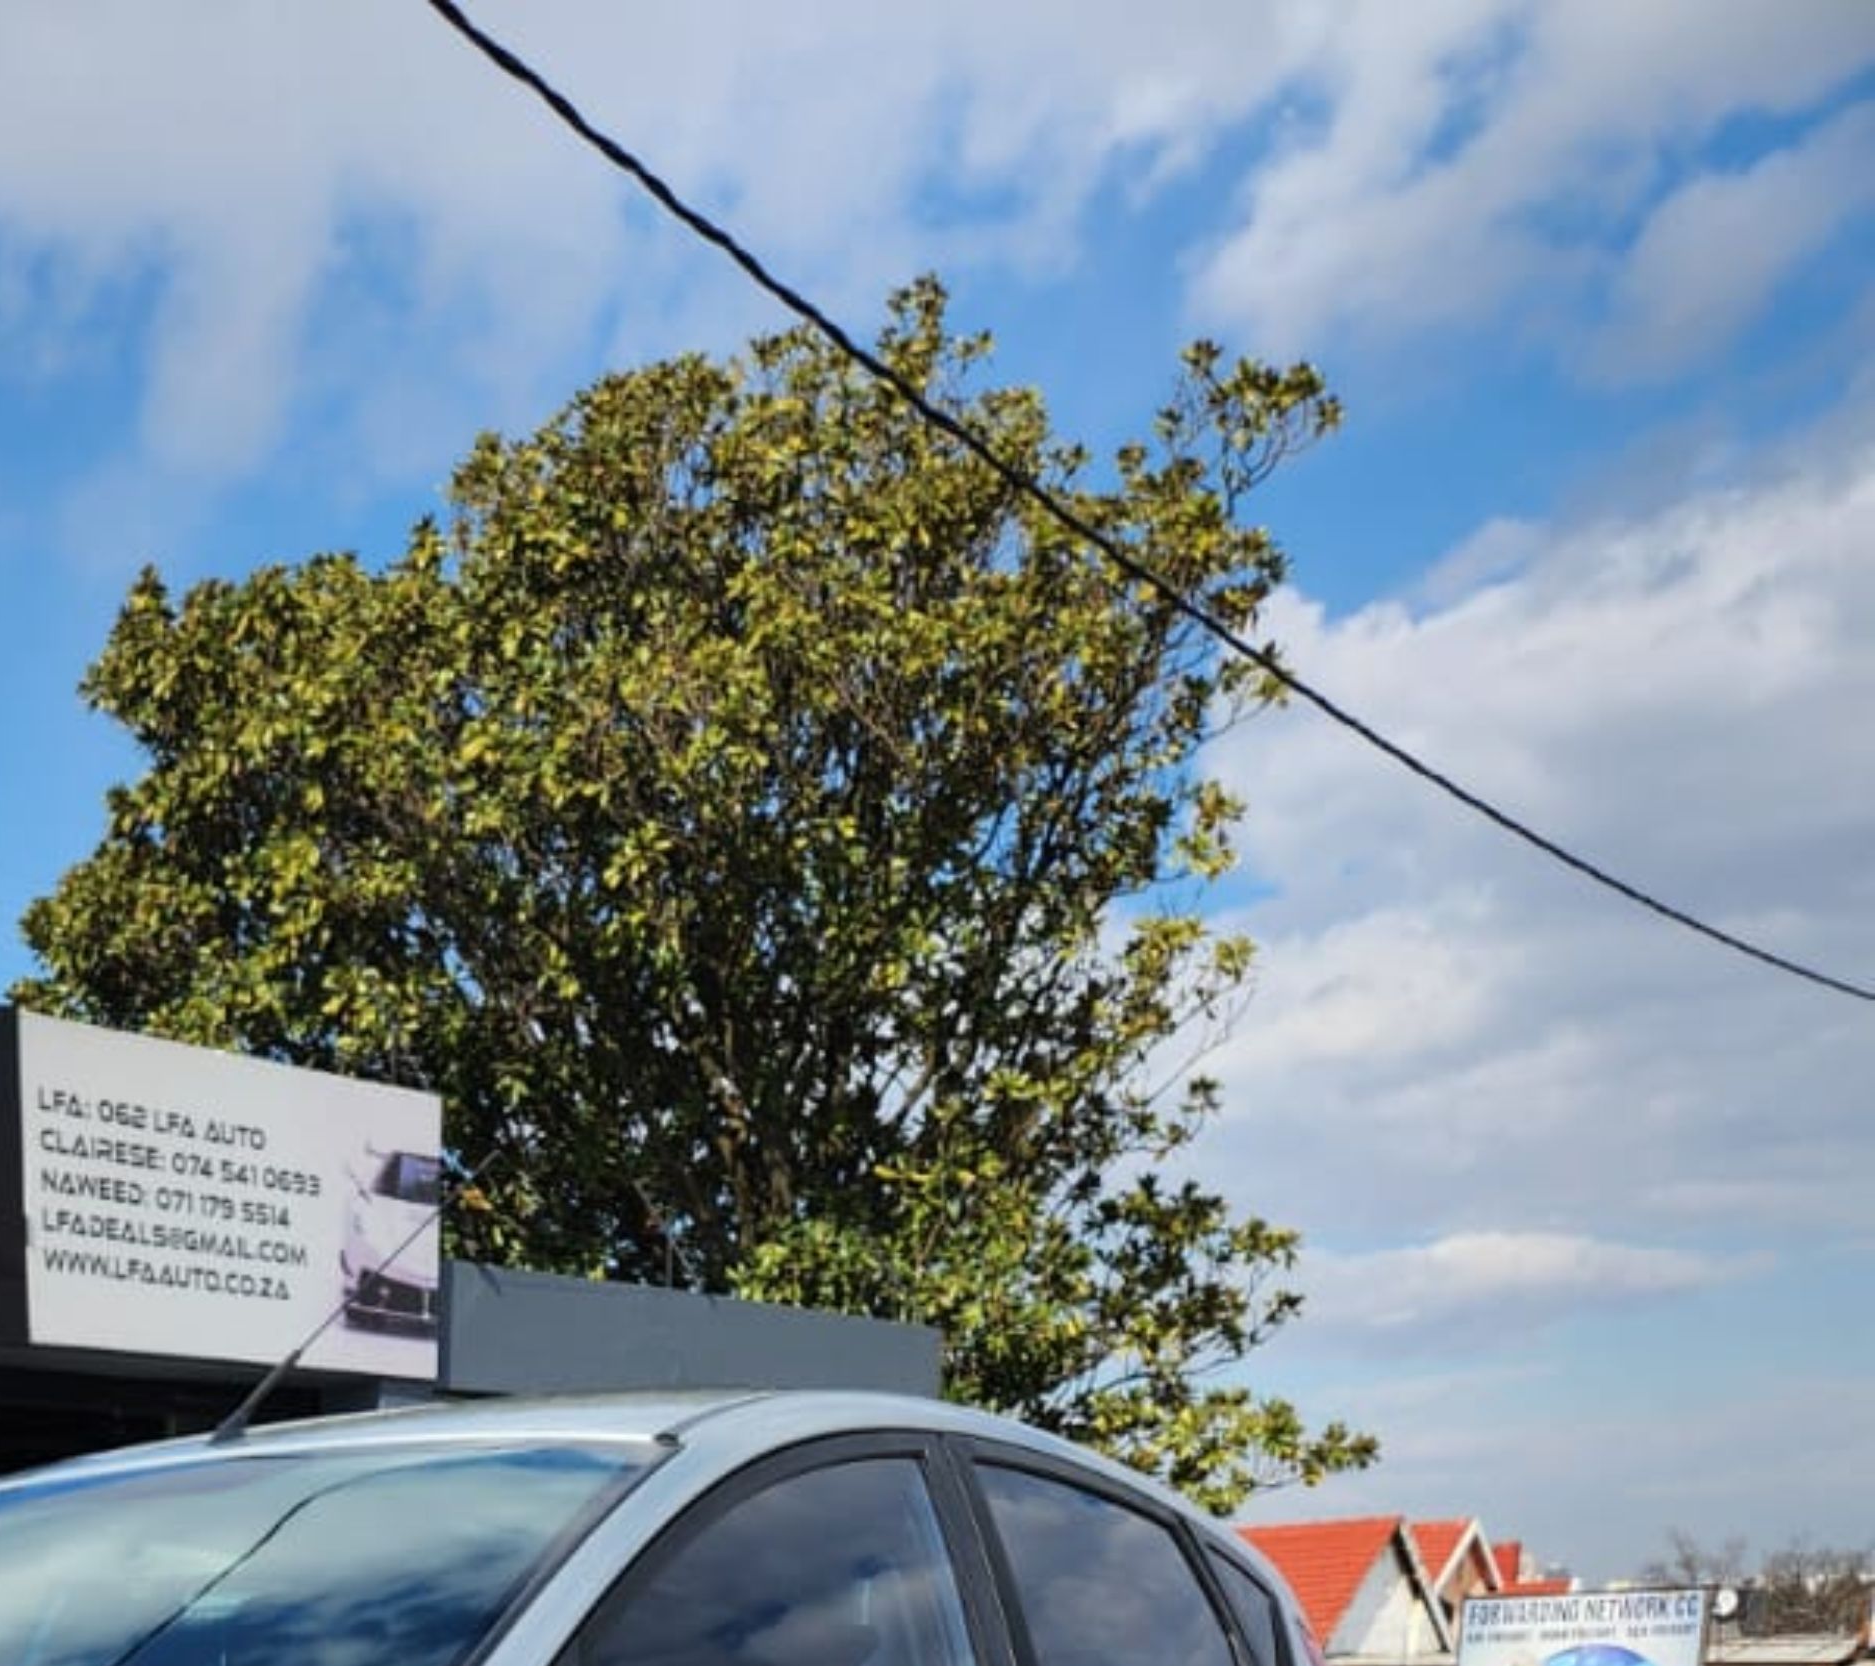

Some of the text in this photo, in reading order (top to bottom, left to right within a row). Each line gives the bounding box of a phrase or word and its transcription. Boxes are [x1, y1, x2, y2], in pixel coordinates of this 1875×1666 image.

[37, 1086, 267, 1151] LFA: 062 LFA AUTO
[171, 1151, 214, 1179] 074
[220, 1159, 258, 1185] 541
[155, 1186, 193, 1212] 071
[1467, 1599, 1579, 1625] FORWARDING
[1583, 1595, 1667, 1622] NETWORK
